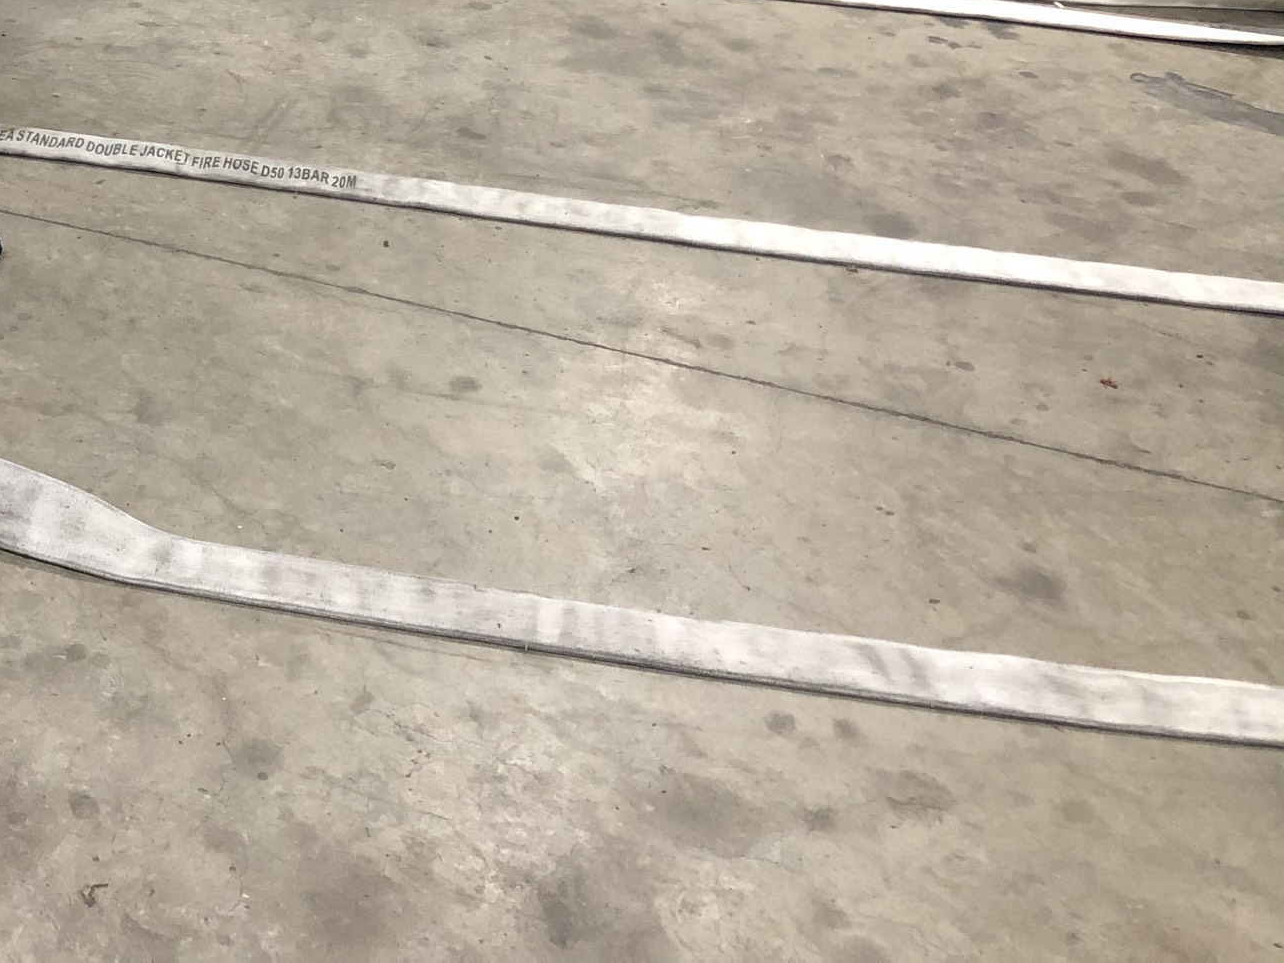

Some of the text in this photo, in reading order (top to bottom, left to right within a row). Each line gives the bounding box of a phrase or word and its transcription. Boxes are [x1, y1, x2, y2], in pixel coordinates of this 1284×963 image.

[16, 130, 85, 149] STANDARD
[85, 140, 139, 157] DOUBLE
[139, 144, 191, 164] JACKET
[191, 156, 221, 170] FIRE
[222, 157, 259, 175] HOSE
[260, 165, 285, 179] D50
[288, 167, 330, 185] 13BAR
[331, 175, 357, 188] 20M
